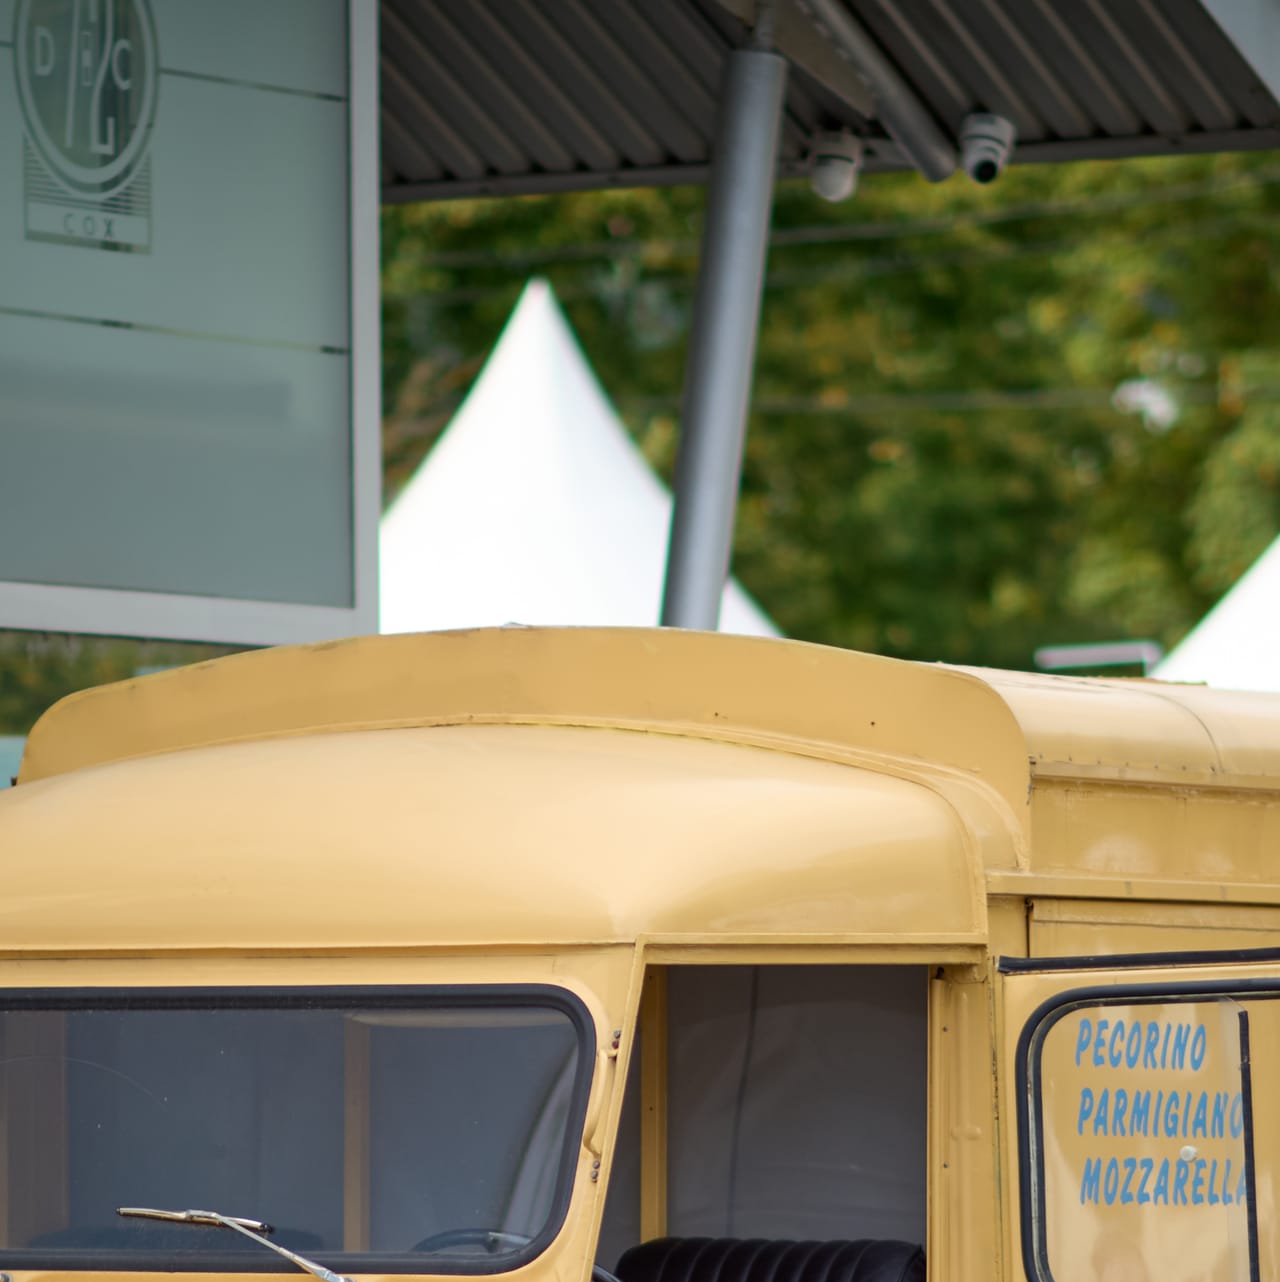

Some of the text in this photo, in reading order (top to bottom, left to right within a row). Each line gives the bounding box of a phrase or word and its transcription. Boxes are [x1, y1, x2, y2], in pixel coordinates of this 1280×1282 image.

[62, 212, 116, 239] COX
[1075, 1018, 1207, 1072] PECORINO
[1077, 1087, 1243, 1140] PARMIGIANO
